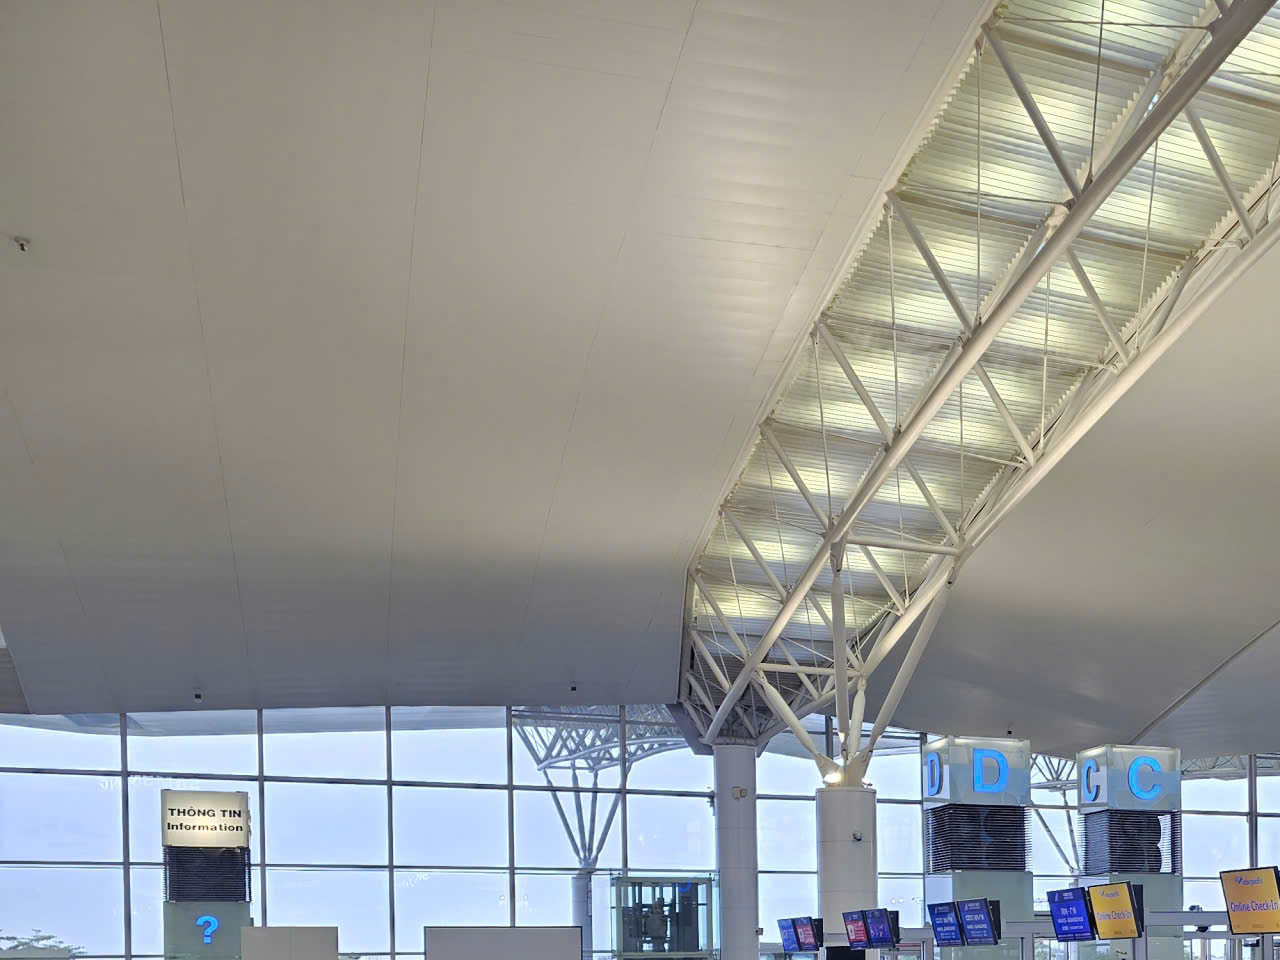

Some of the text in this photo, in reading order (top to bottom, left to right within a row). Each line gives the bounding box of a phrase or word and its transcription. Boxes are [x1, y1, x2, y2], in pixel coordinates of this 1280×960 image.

[927, 751, 943, 797] D
[973, 748, 1009, 793] D
[1083, 759, 1101, 802] C
[1128, 756, 1161, 800] C
[167, 822, 243, 832] Information
[168, 806, 242, 818] THÔNG TIN
